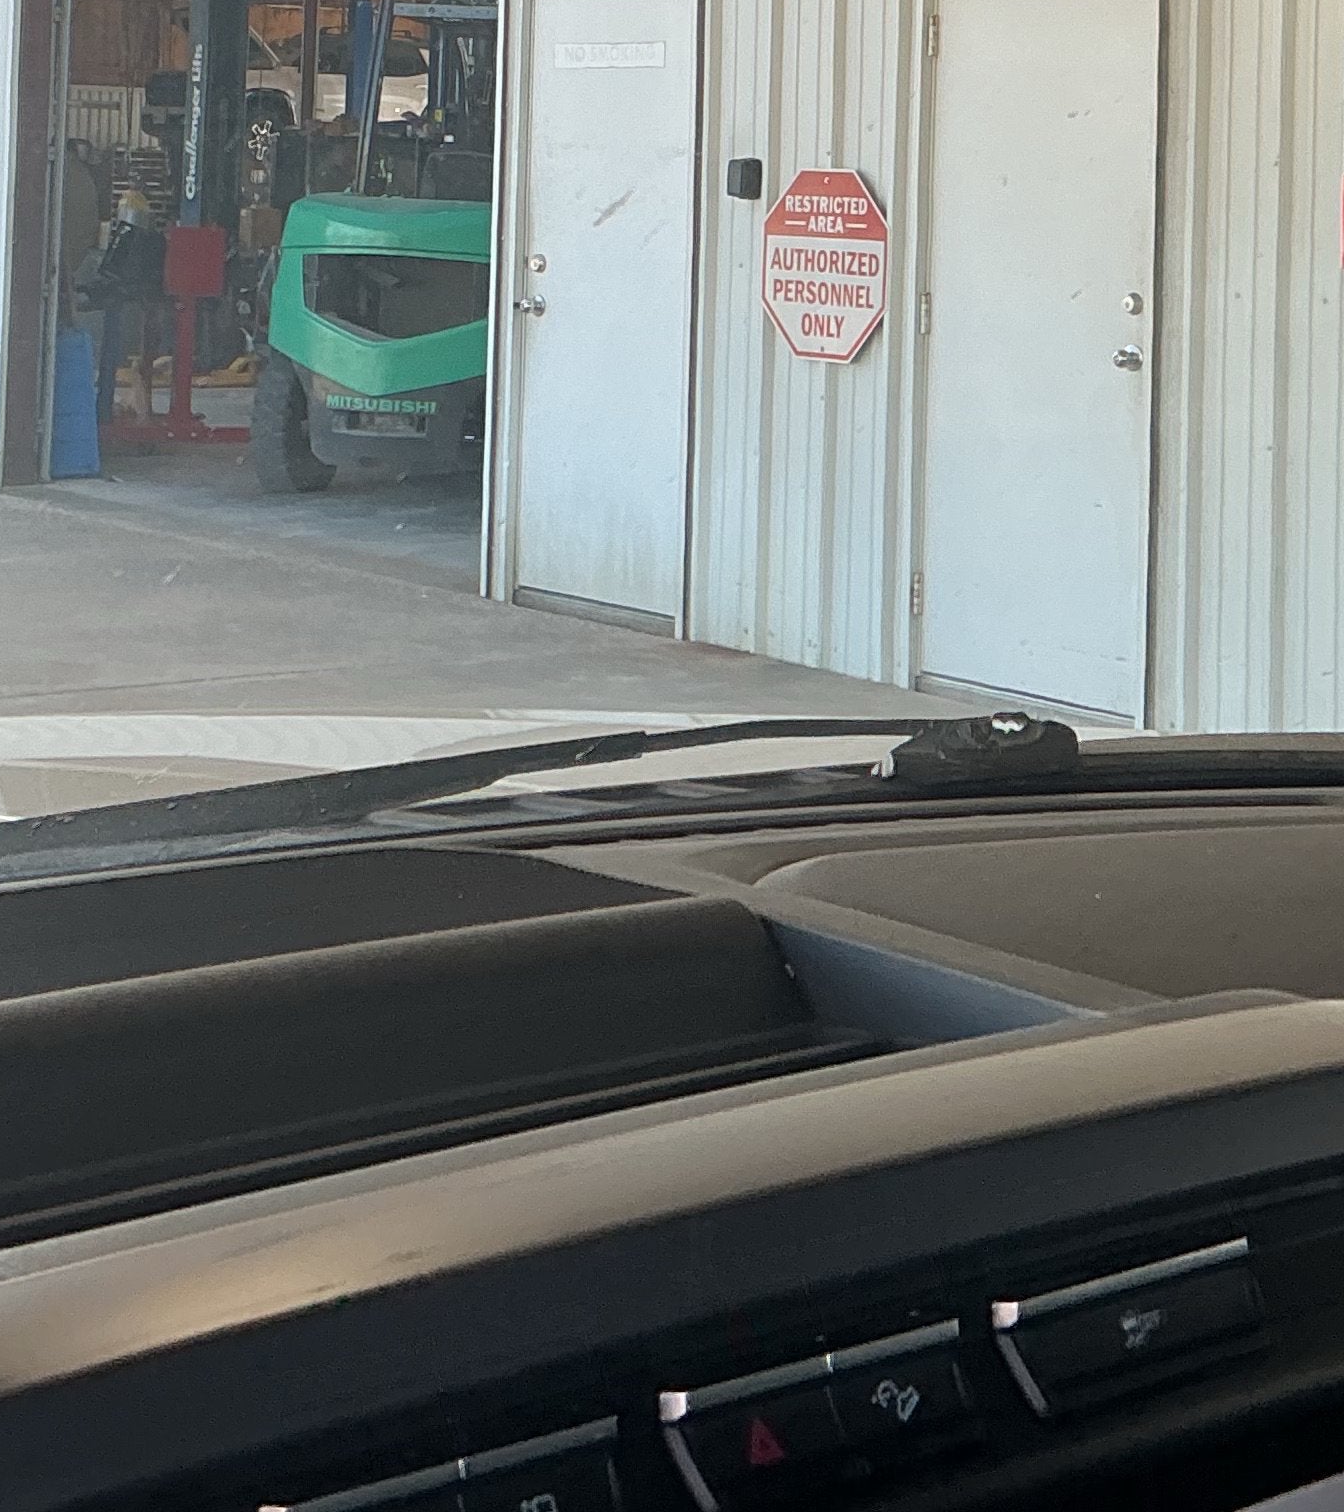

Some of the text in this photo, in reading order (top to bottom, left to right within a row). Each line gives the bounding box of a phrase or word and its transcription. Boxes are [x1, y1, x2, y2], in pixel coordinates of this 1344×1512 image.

[185, 85, 202, 201] Challenger
[785, 195, 868, 216] RESTRICTED
[807, 216, 844, 233] AREA
[770, 247, 880, 277] AUTHORIZED
[773, 278, 874, 309] PERSONNEL
[801, 313, 845, 338] ONLY
[326, 394, 437, 415] MITSUBISHI
